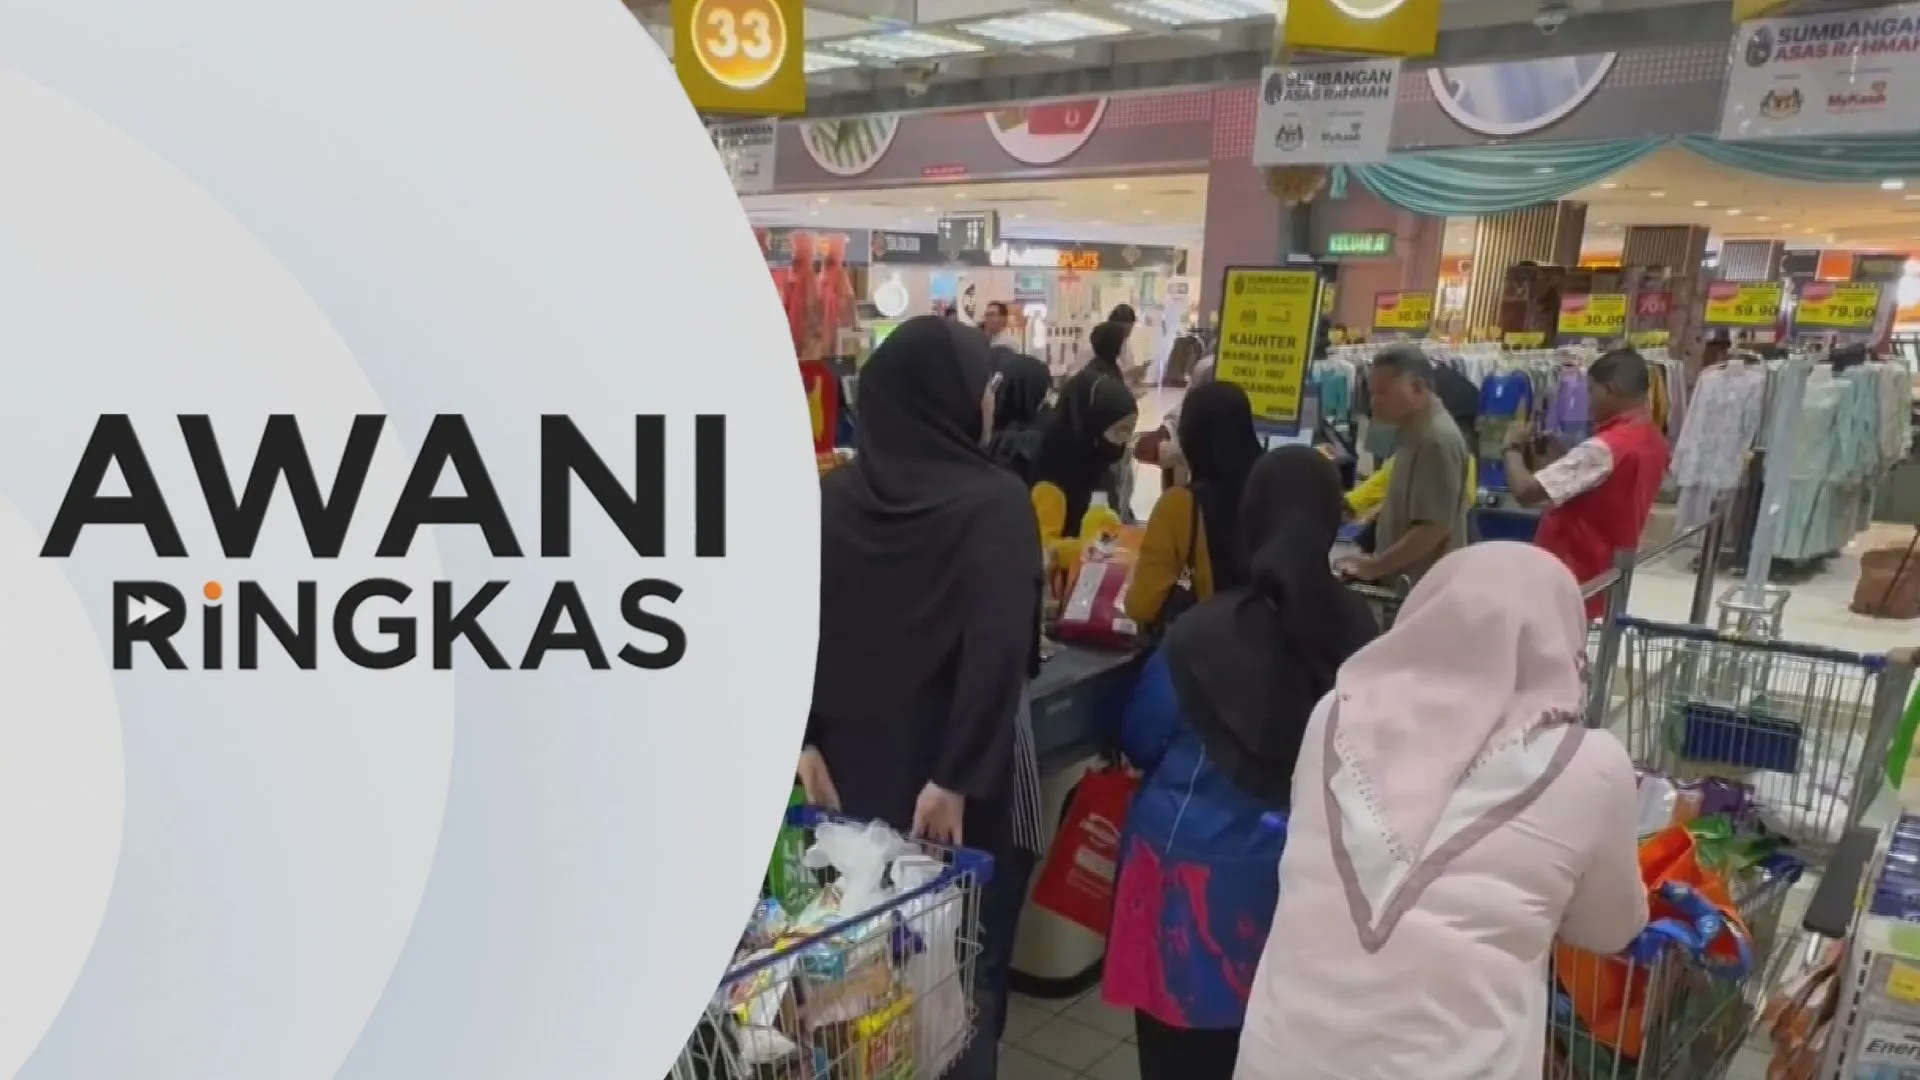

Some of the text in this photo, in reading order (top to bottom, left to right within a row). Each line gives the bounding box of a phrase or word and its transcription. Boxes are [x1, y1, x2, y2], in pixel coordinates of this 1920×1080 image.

[707, 8, 772, 59] 33
[1777, 16, 1920, 44] SUMBANGA
[1774, 44, 1828, 61] ASAS
[1286, 68, 1392, 87] SUMBANGAN
[1284, 85, 1389, 101] ASAS RAHMAH
[1734, 304, 1780, 317] 59.90
[1828, 304, 1876, 318] 79.90
[1584, 314, 1626, 327] 30.00
[1229, 332, 1297, 350] KAUNTER
[1865, 1036, 1920, 1060] Ener
